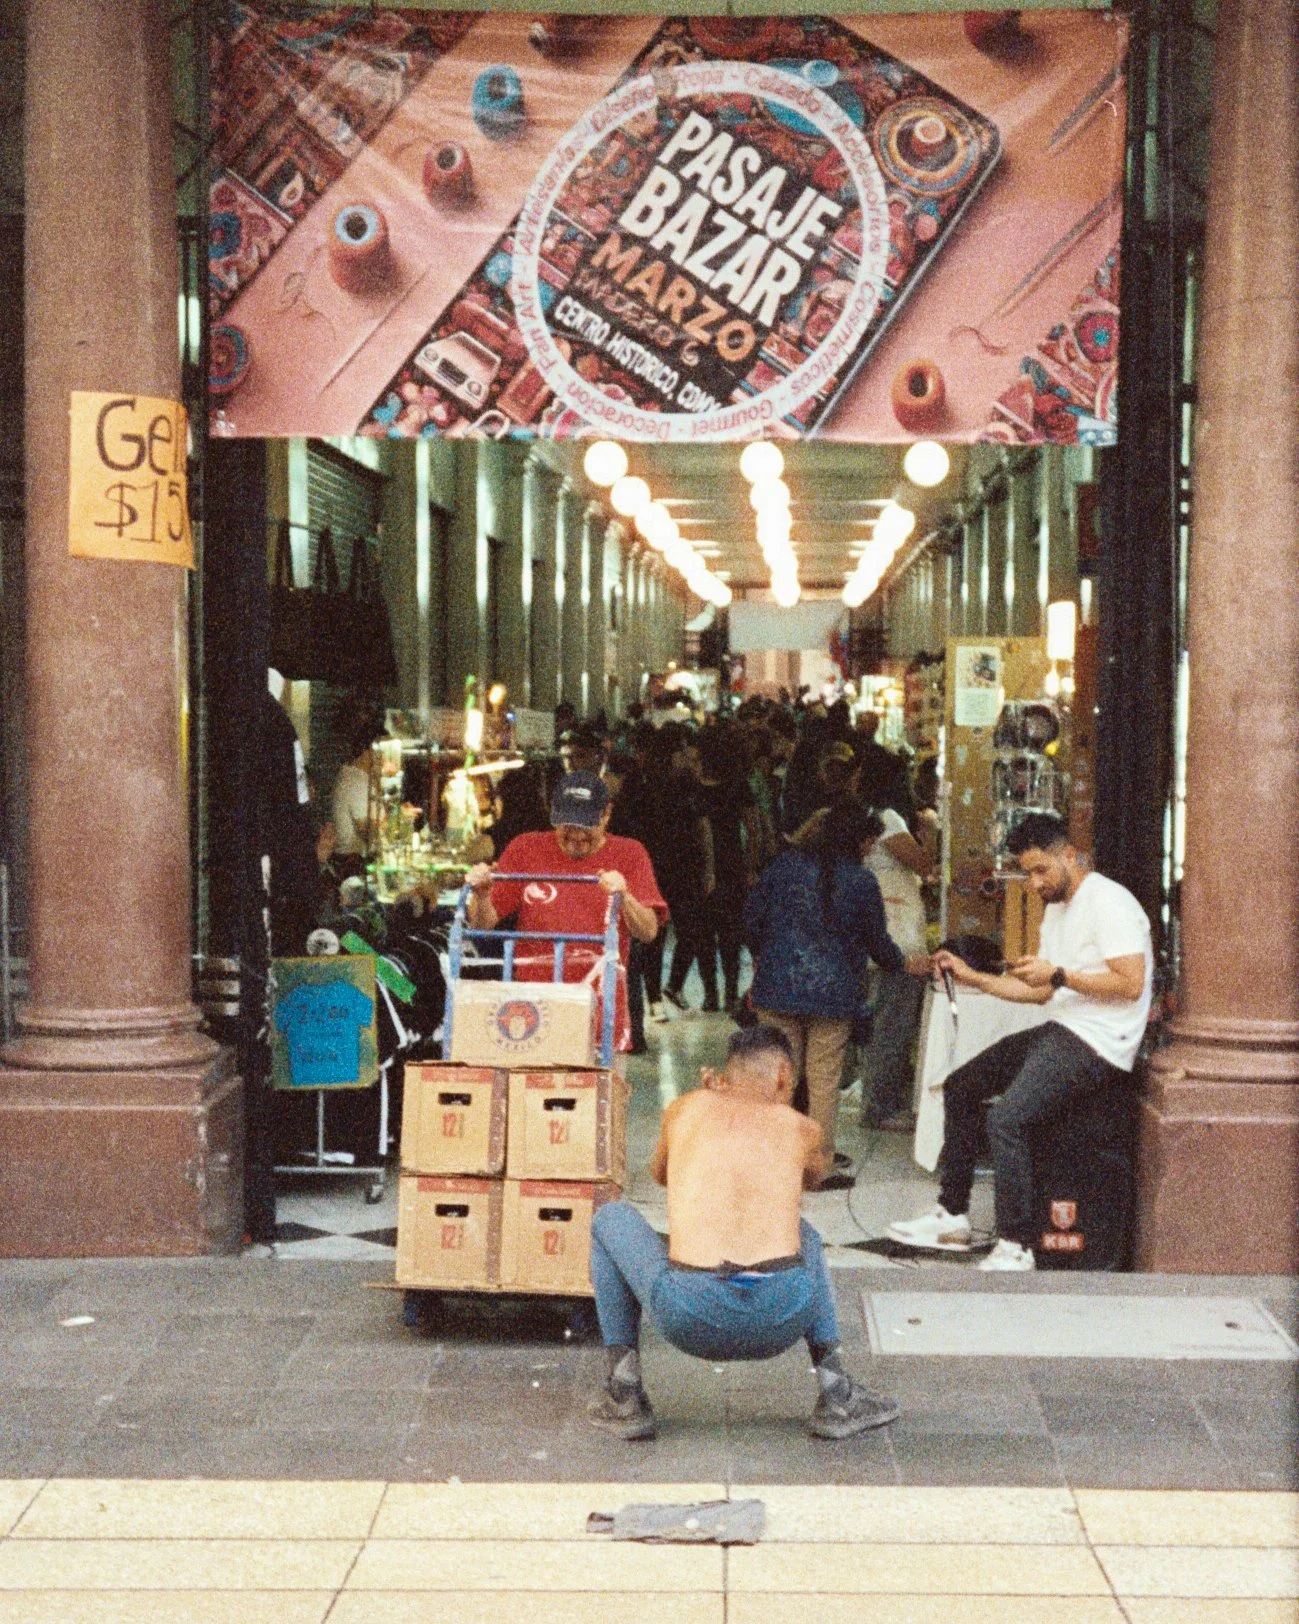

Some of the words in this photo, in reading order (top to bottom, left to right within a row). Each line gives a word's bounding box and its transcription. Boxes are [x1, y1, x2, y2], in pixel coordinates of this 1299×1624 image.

[744, 67, 821, 114] Calzado
[657, 110, 844, 260] PASAJE
[618, 164, 803, 327] BAZAR
[517, 282, 536, 320] Art
[554, 295, 612, 346] CENTRO
[590, 232, 757, 362] MARZO
[690, 399, 773, 435] Gourmet
[94, 480, 184, 543] $15
